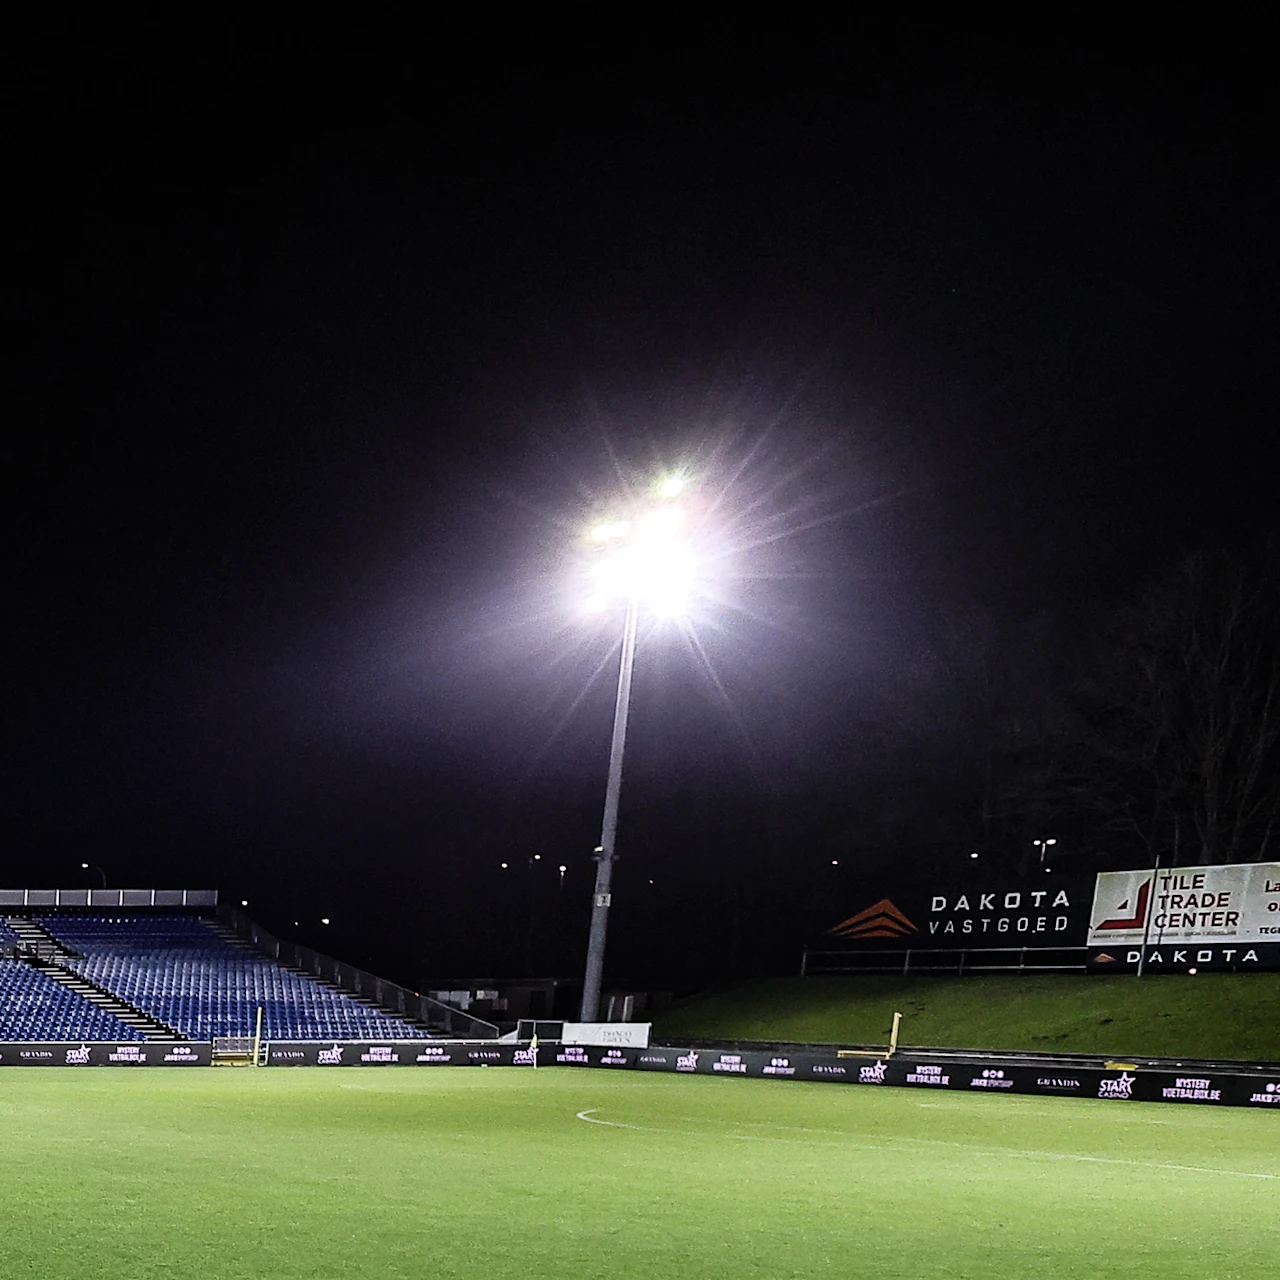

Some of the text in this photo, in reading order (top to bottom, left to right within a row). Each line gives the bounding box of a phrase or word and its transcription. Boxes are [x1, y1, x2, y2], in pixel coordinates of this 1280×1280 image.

[1160, 874, 1205, 890] TILE
[931, 890, 1070, 911] DAKOTA
[1158, 892, 1231, 910] TRADE
[929, 916, 1068, 934] VASTGOED
[1154, 911, 1239, 928] CENTER
[1126, 950, 1259, 963] DAKOTA
